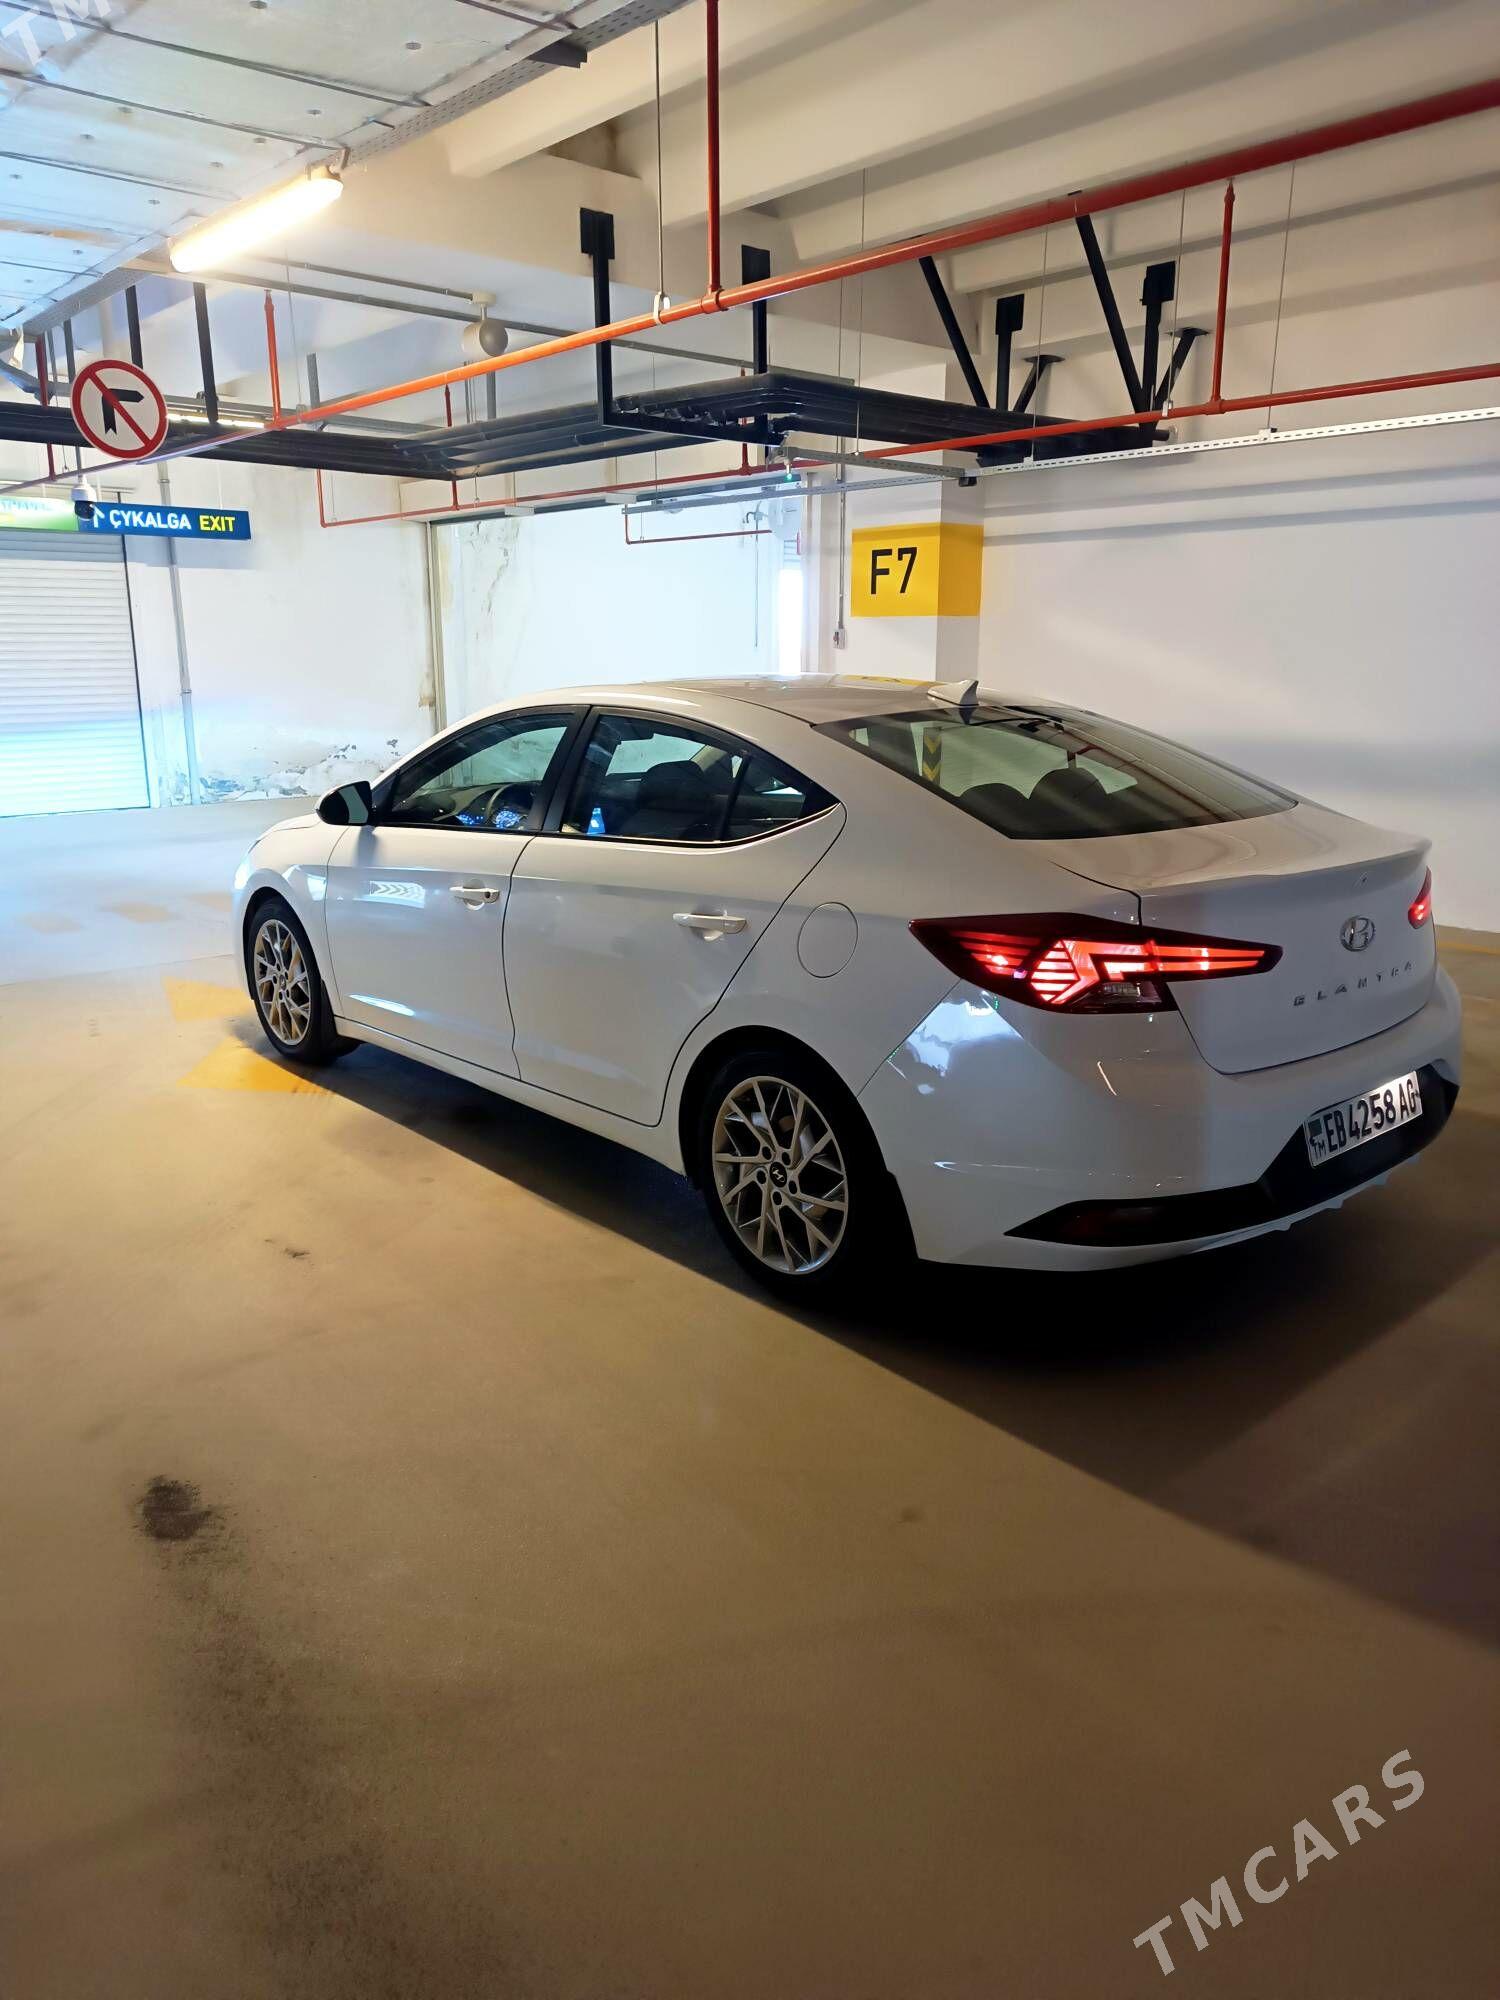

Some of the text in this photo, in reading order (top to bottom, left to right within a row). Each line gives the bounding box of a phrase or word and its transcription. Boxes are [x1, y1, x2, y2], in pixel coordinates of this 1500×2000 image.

[109, 509, 236, 532] ÇYKALGA EXIT
[870, 546, 918, 595] F7
[1293, 960, 1413, 1007] ELANTRA
[1348, 1089, 1397, 1141] 4258
[1398, 1078, 1417, 1120] AG
